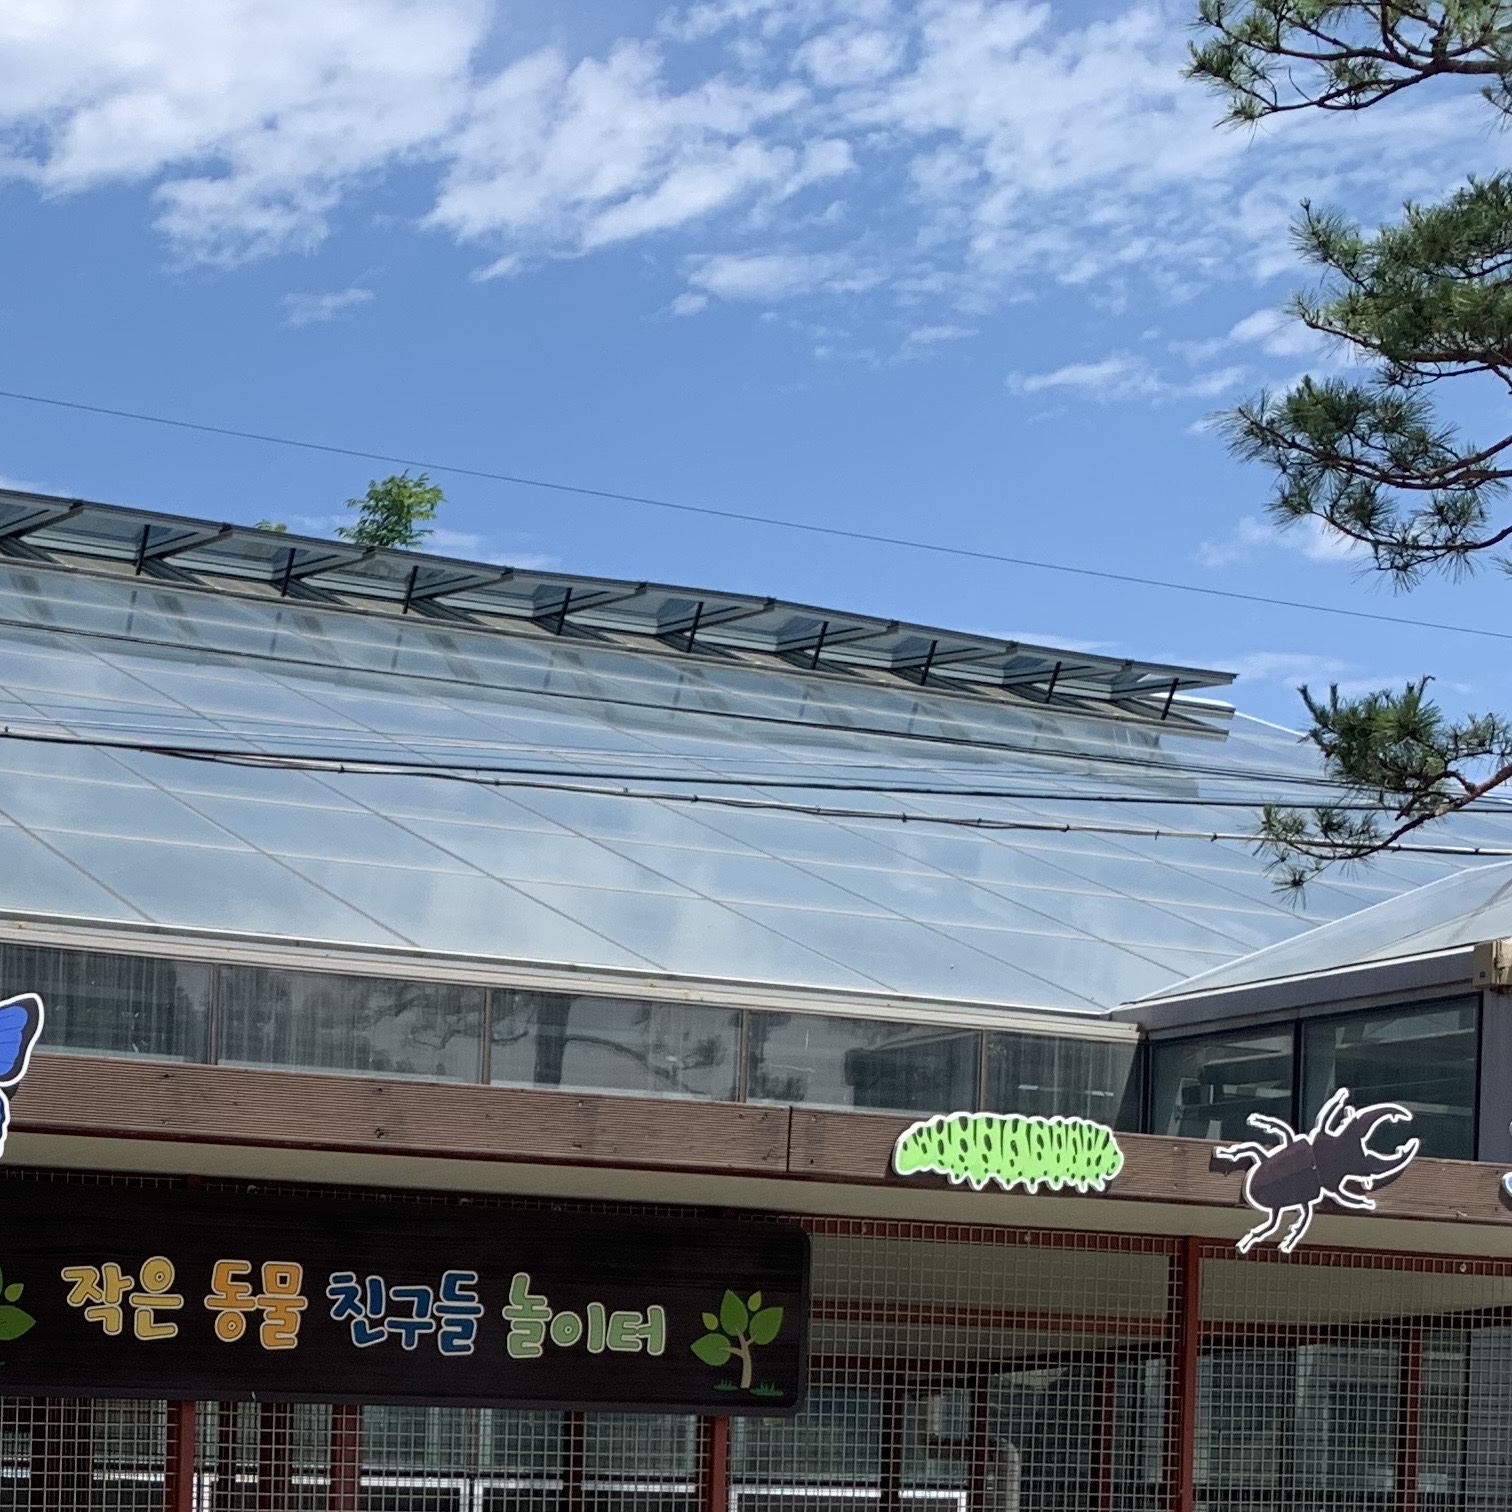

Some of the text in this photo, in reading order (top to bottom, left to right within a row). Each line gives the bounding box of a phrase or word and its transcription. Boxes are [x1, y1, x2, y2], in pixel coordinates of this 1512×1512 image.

[61, 1255, 666, 1359] 작은 동물 친구들 놀이터
